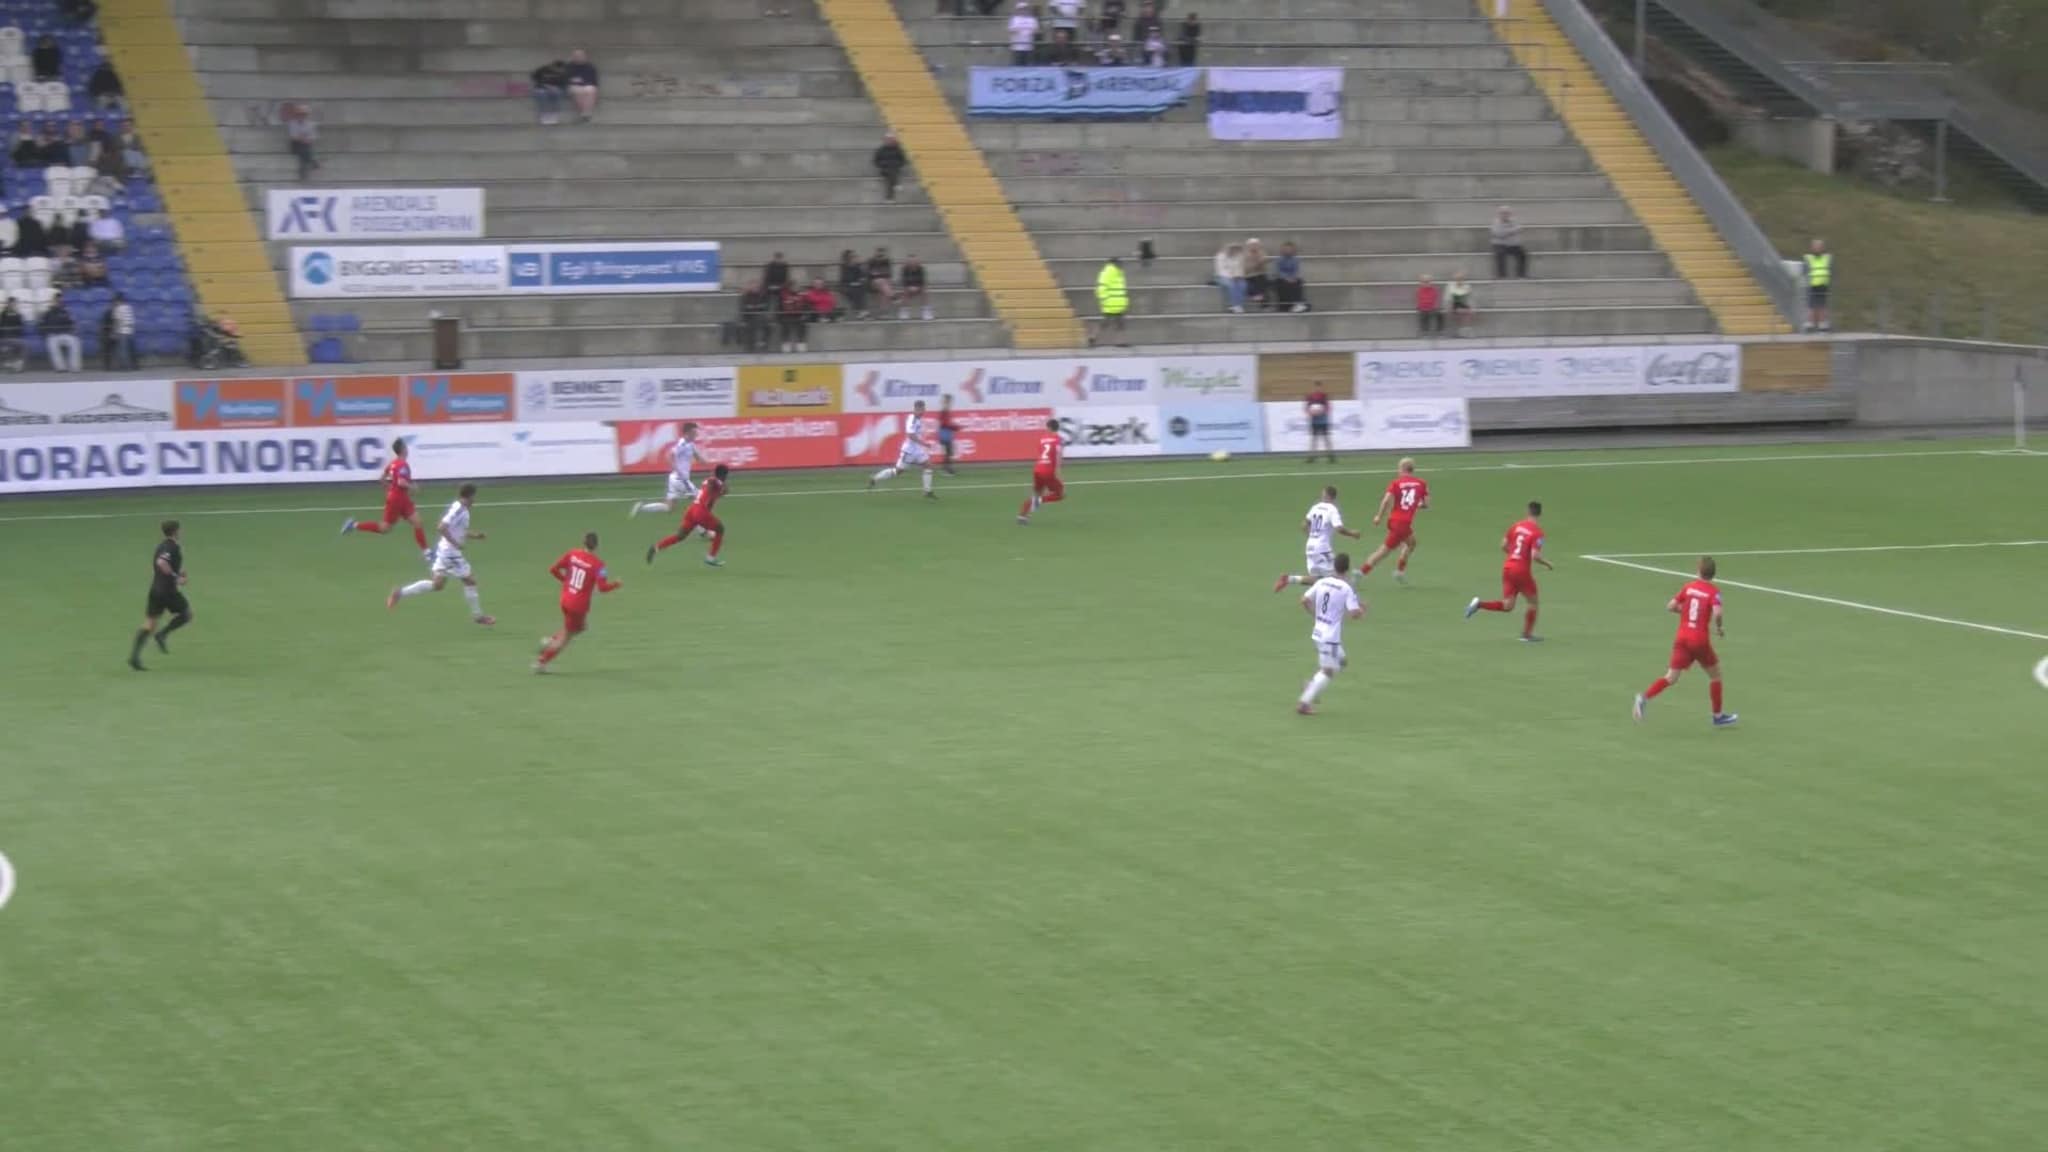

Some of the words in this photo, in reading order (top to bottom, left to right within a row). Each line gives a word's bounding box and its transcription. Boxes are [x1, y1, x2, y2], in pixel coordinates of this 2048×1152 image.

[991, 77, 1055, 93] FORZA
[0, 443, 147, 483] ORAC
[215, 436, 384, 474] NORAC
[569, 565, 587, 590] 10
[1320, 591, 1330, 615] 8
